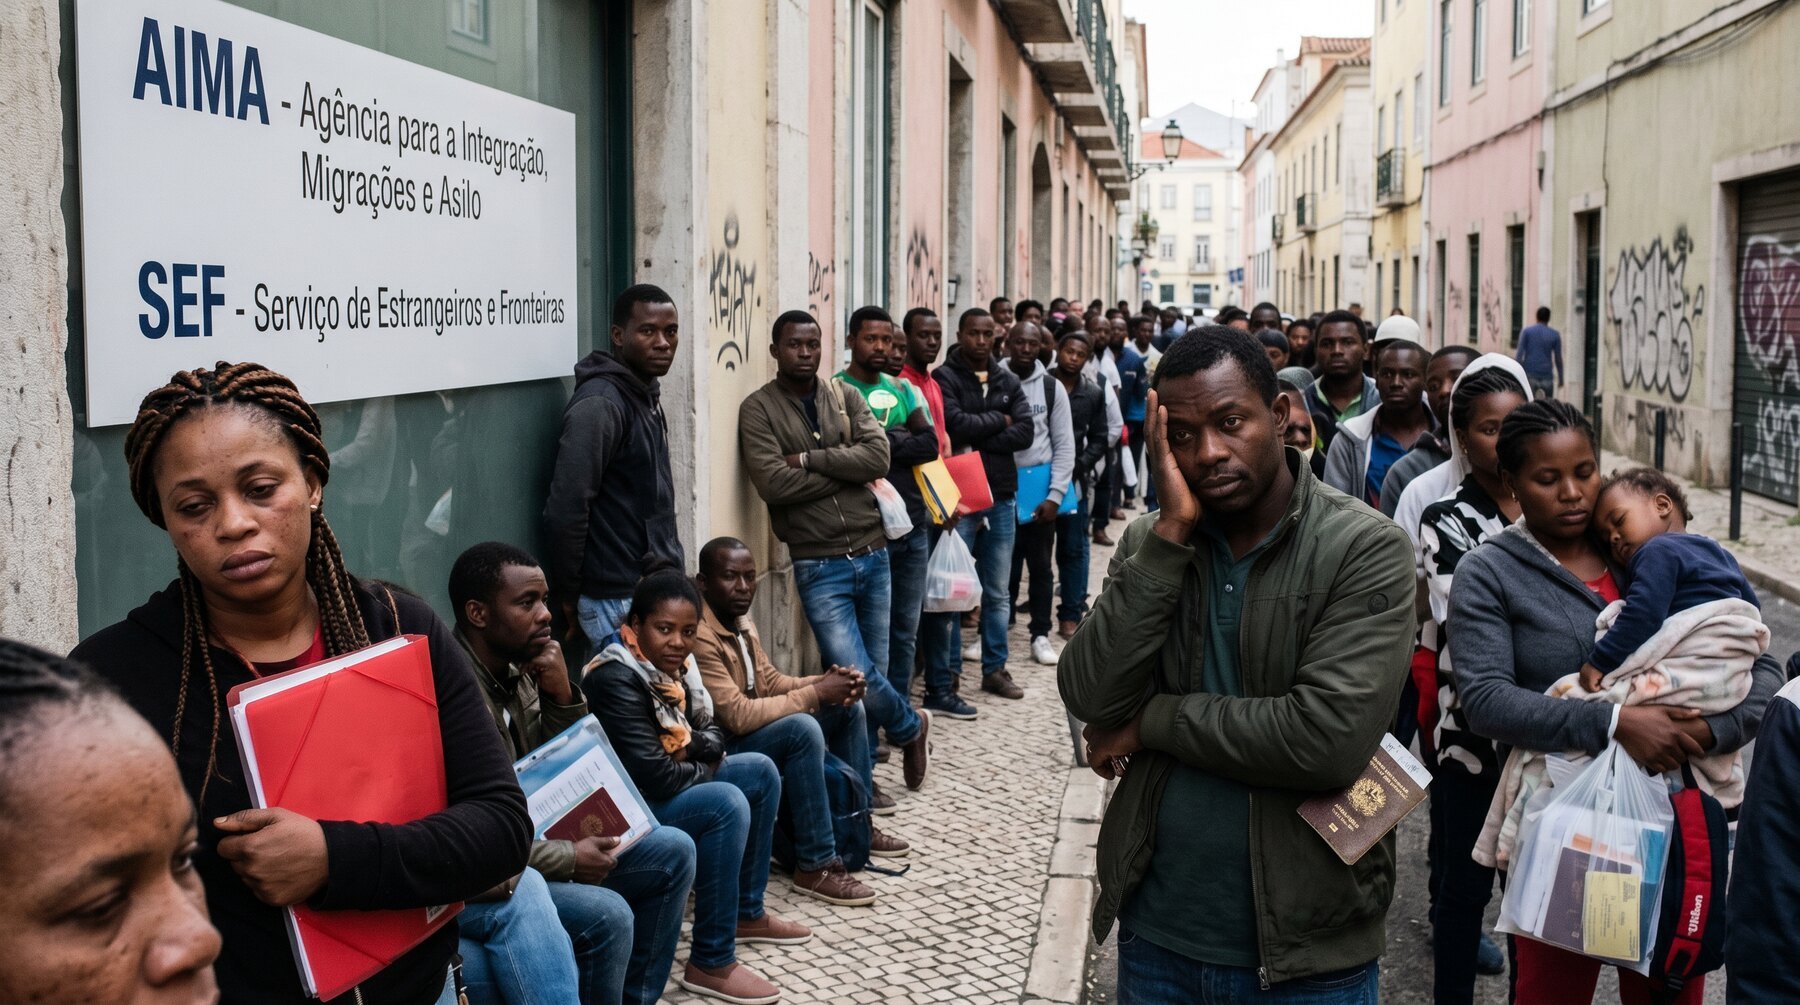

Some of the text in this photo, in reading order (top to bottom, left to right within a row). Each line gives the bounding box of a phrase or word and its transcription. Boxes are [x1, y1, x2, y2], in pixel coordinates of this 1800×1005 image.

[132, 16, 271, 127] AIMA
[299, 81, 392, 146] Agência
[398, 115, 441, 158] para
[446, 126, 458, 159] a
[462, 120, 549, 184] Integração,
[301, 150, 482, 220] Migrações e Asilo
[137, 260, 227, 340] SEF
[253, 282, 341, 343] Serviço
[346, 285, 372, 330] de
[377, 286, 483, 338] Estrangeiros
[487, 297, 496, 326] e
[499, 289, 566, 325] Fronteiras
